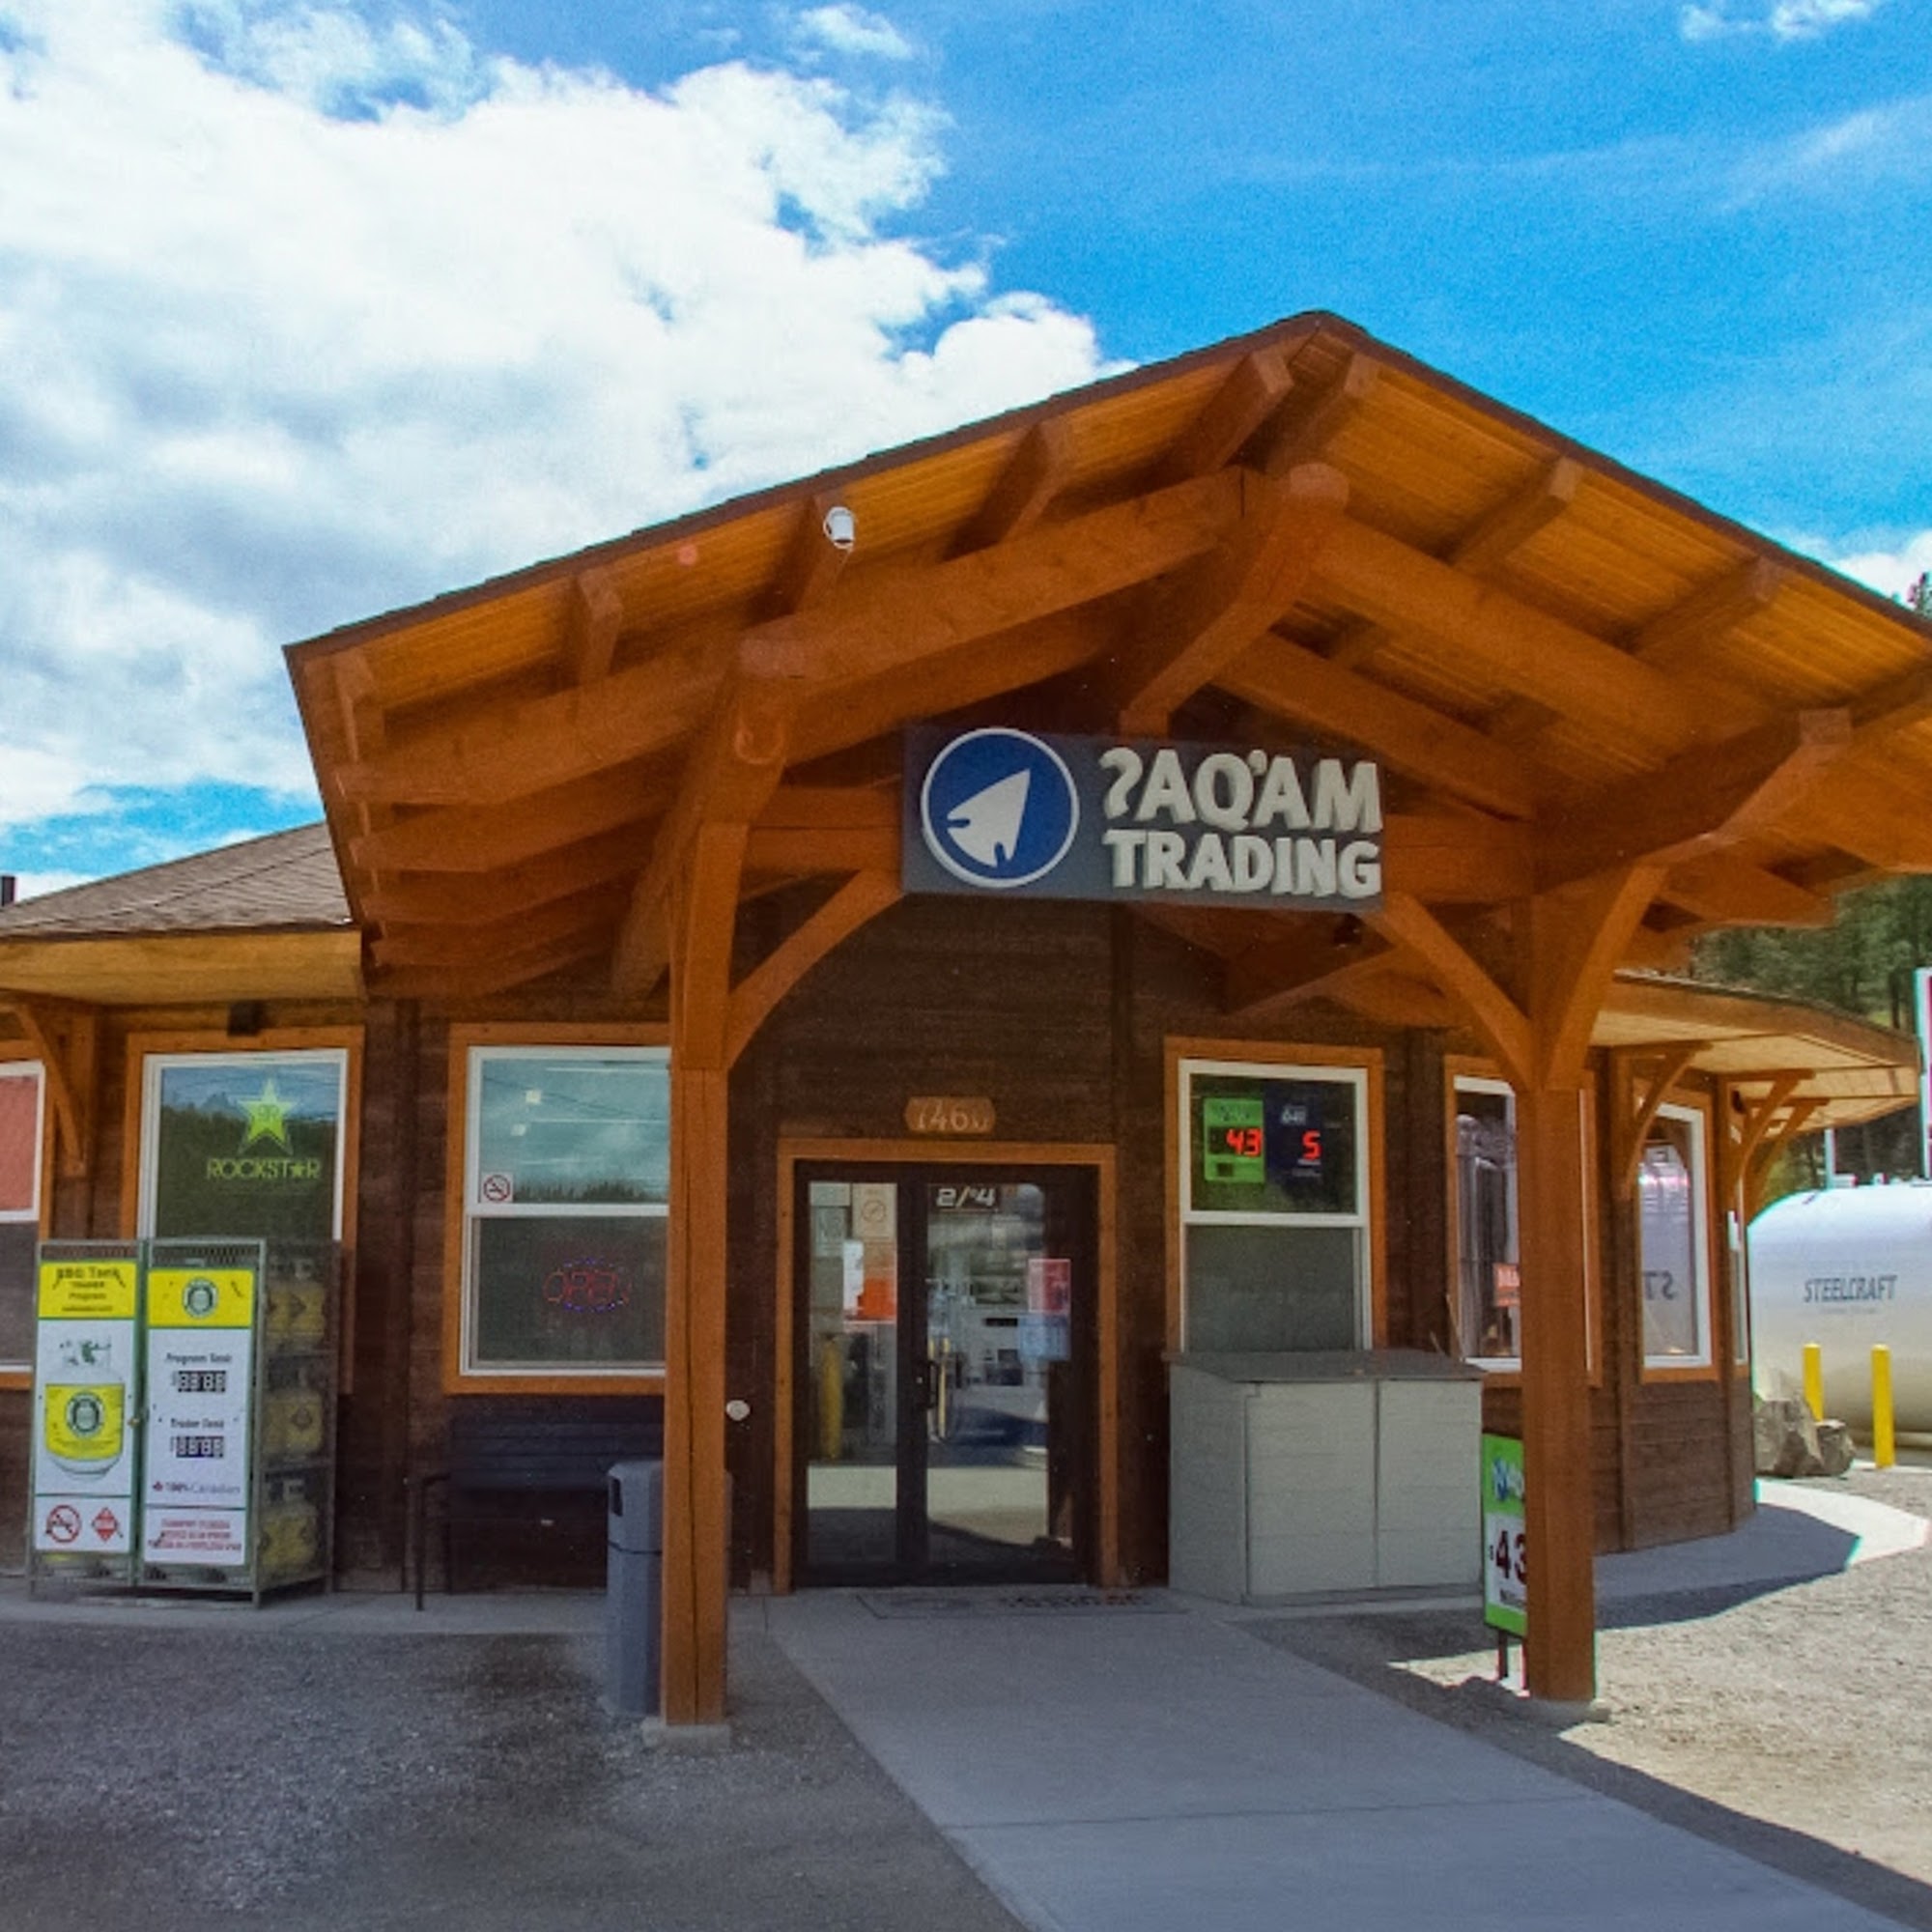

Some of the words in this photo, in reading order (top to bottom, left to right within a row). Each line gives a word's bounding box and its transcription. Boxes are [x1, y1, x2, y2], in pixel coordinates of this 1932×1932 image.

[1101, 829, 1383, 898] TRADING
[1225, 1128, 1263, 1157] 43
[1804, 1274, 1897, 1303] STEELCRAFT
